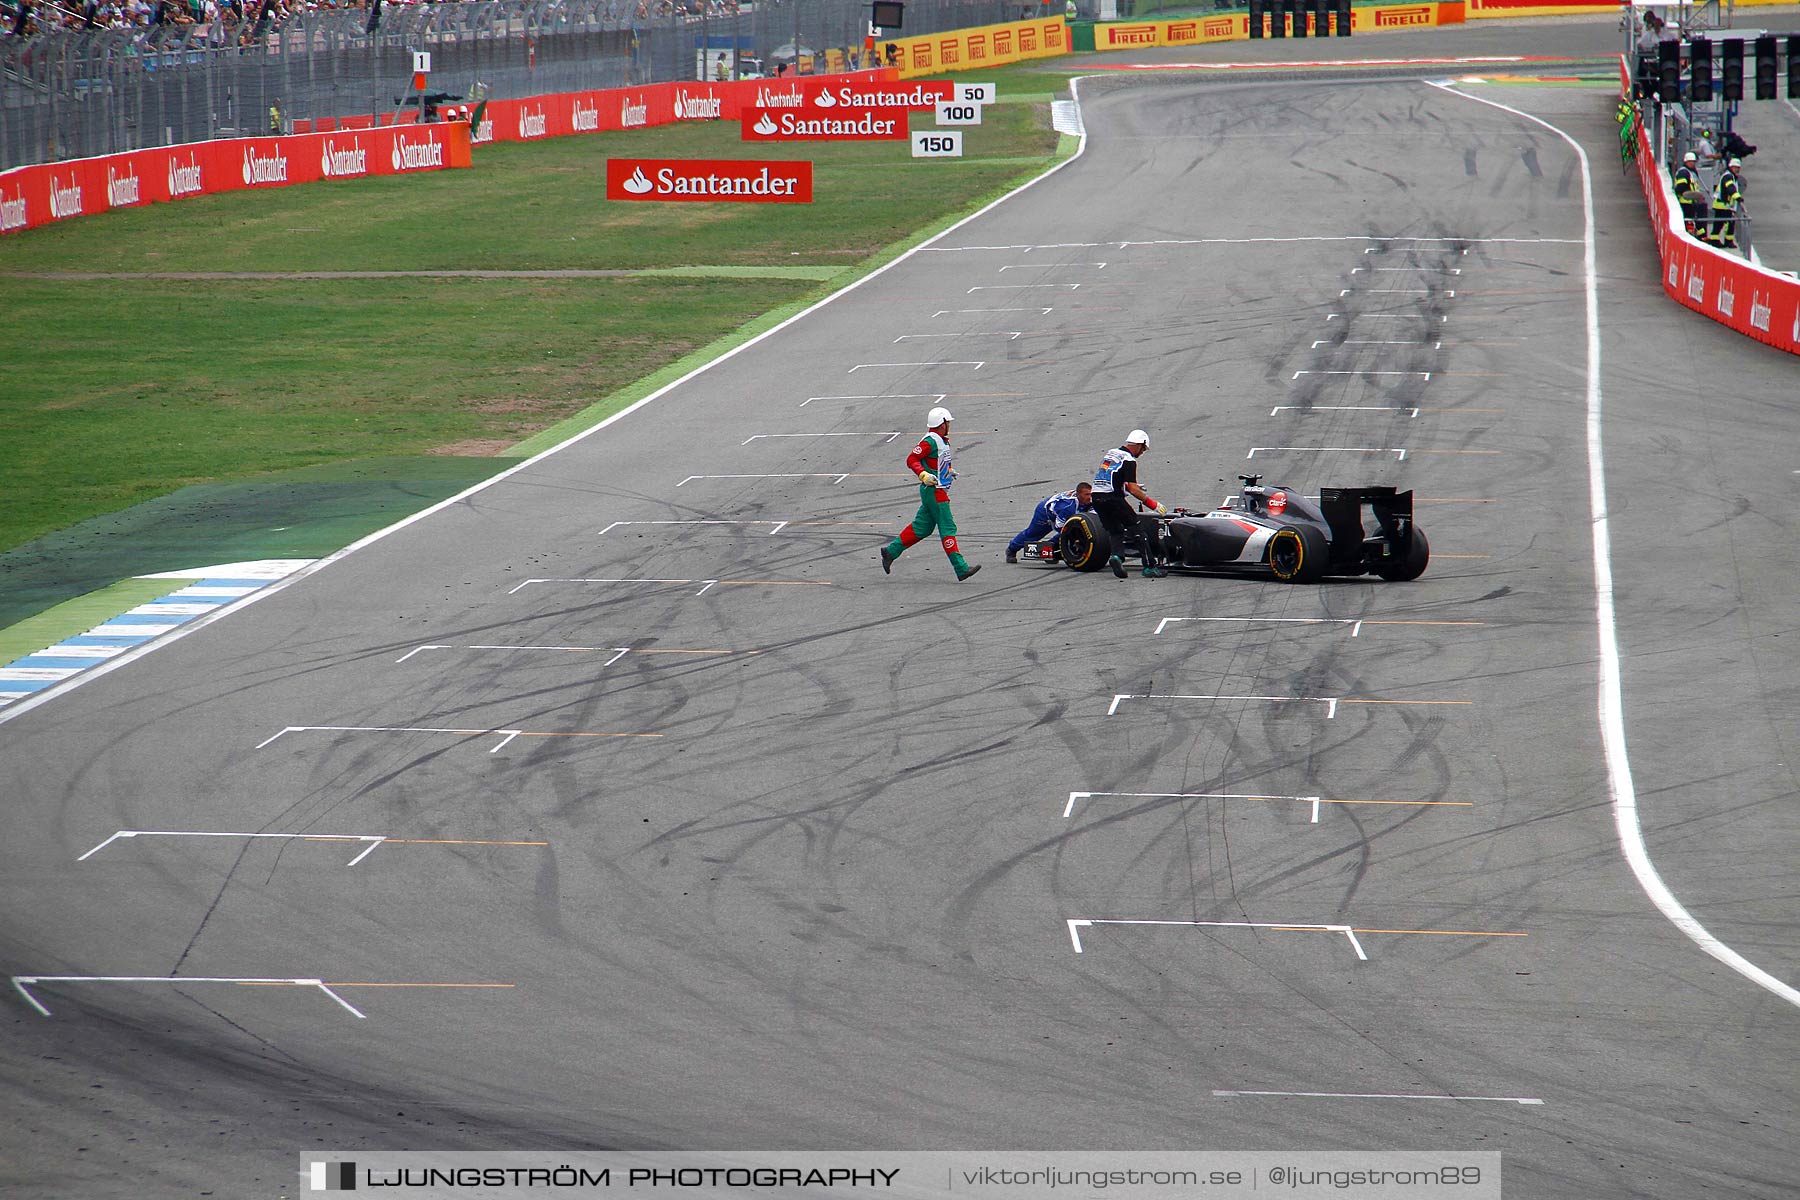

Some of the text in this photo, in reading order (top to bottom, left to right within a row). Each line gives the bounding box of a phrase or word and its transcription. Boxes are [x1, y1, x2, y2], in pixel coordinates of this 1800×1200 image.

[1204, 19, 1233, 37] PIRELLI
[1375, 7, 1430, 26] PIRELLI
[993, 31, 1010, 56] PIRELLI
[1018, 28, 1036, 52] PIRELLI
[1044, 24, 1062, 48] PIRELLI
[1108, 26, 1156, 44] PIRELLI
[1168, 23, 1196, 41] PIRELLI
[913, 43, 932, 69] PIRELLI
[940, 39, 959, 64] PIRELLI
[967, 35, 986, 60] PIRELLI
[418, 55, 423, 69] 1
[682, 88, 721, 118] Santander
[839, 85, 943, 107] Santander
[964, 88, 985, 101] 50
[781, 112, 896, 135] Santander
[943, 107, 975, 120] 100
[329, 136, 366, 176] Santander
[400, 130, 442, 169] Santander
[919, 138, 954, 152] 150
[249, 143, 287, 184] Santander
[657, 167, 798, 195] Santander
